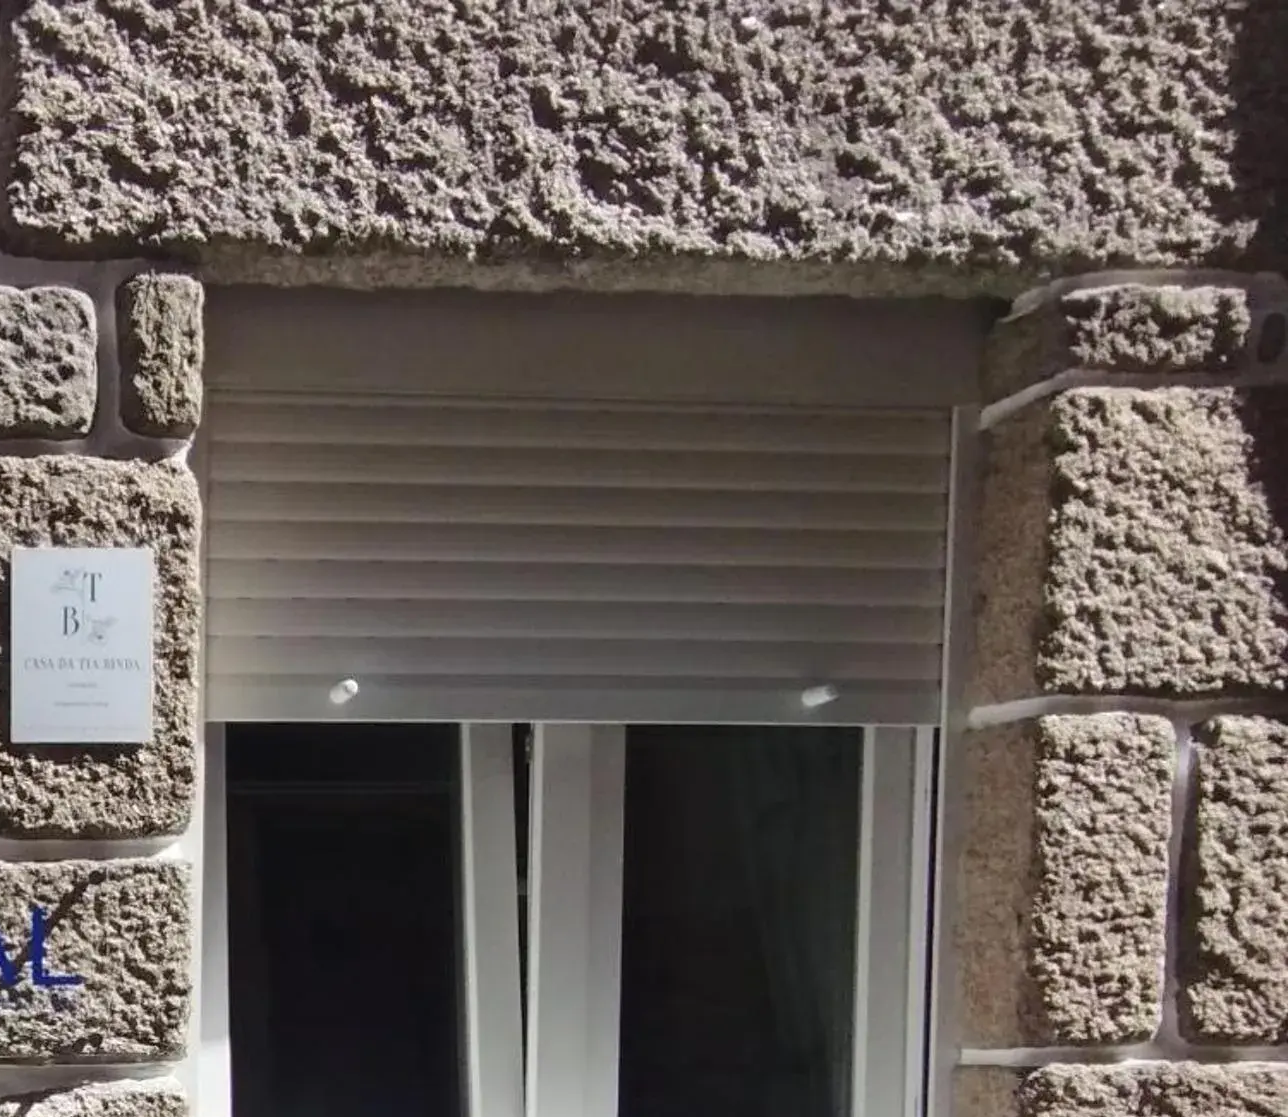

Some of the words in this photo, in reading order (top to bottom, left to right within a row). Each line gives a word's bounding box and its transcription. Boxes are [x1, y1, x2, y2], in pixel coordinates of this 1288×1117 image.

[83, 572, 103, 602] T
[62, 606, 80, 636] B
[24, 656, 55, 671] CASA
